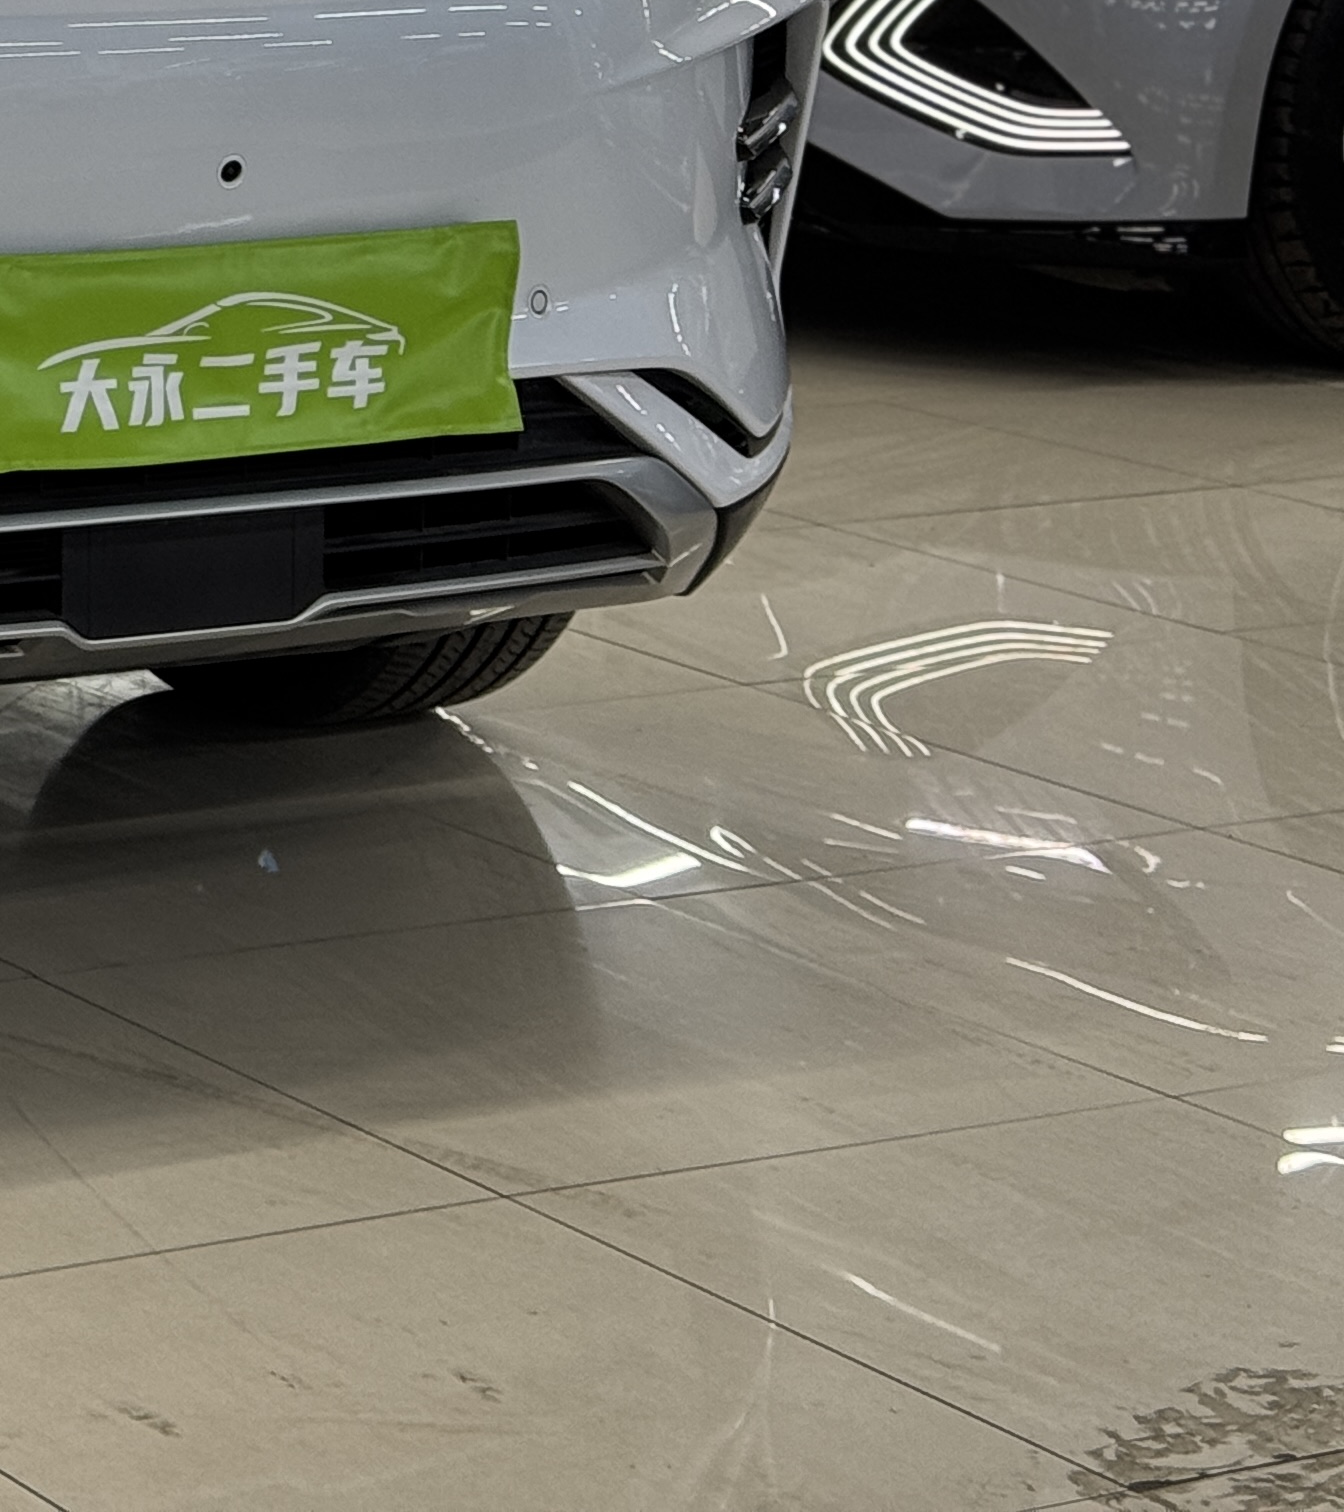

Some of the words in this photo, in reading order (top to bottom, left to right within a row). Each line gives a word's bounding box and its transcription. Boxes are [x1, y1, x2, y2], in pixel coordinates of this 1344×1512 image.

[57, 339, 389, 434] 大永二手车
